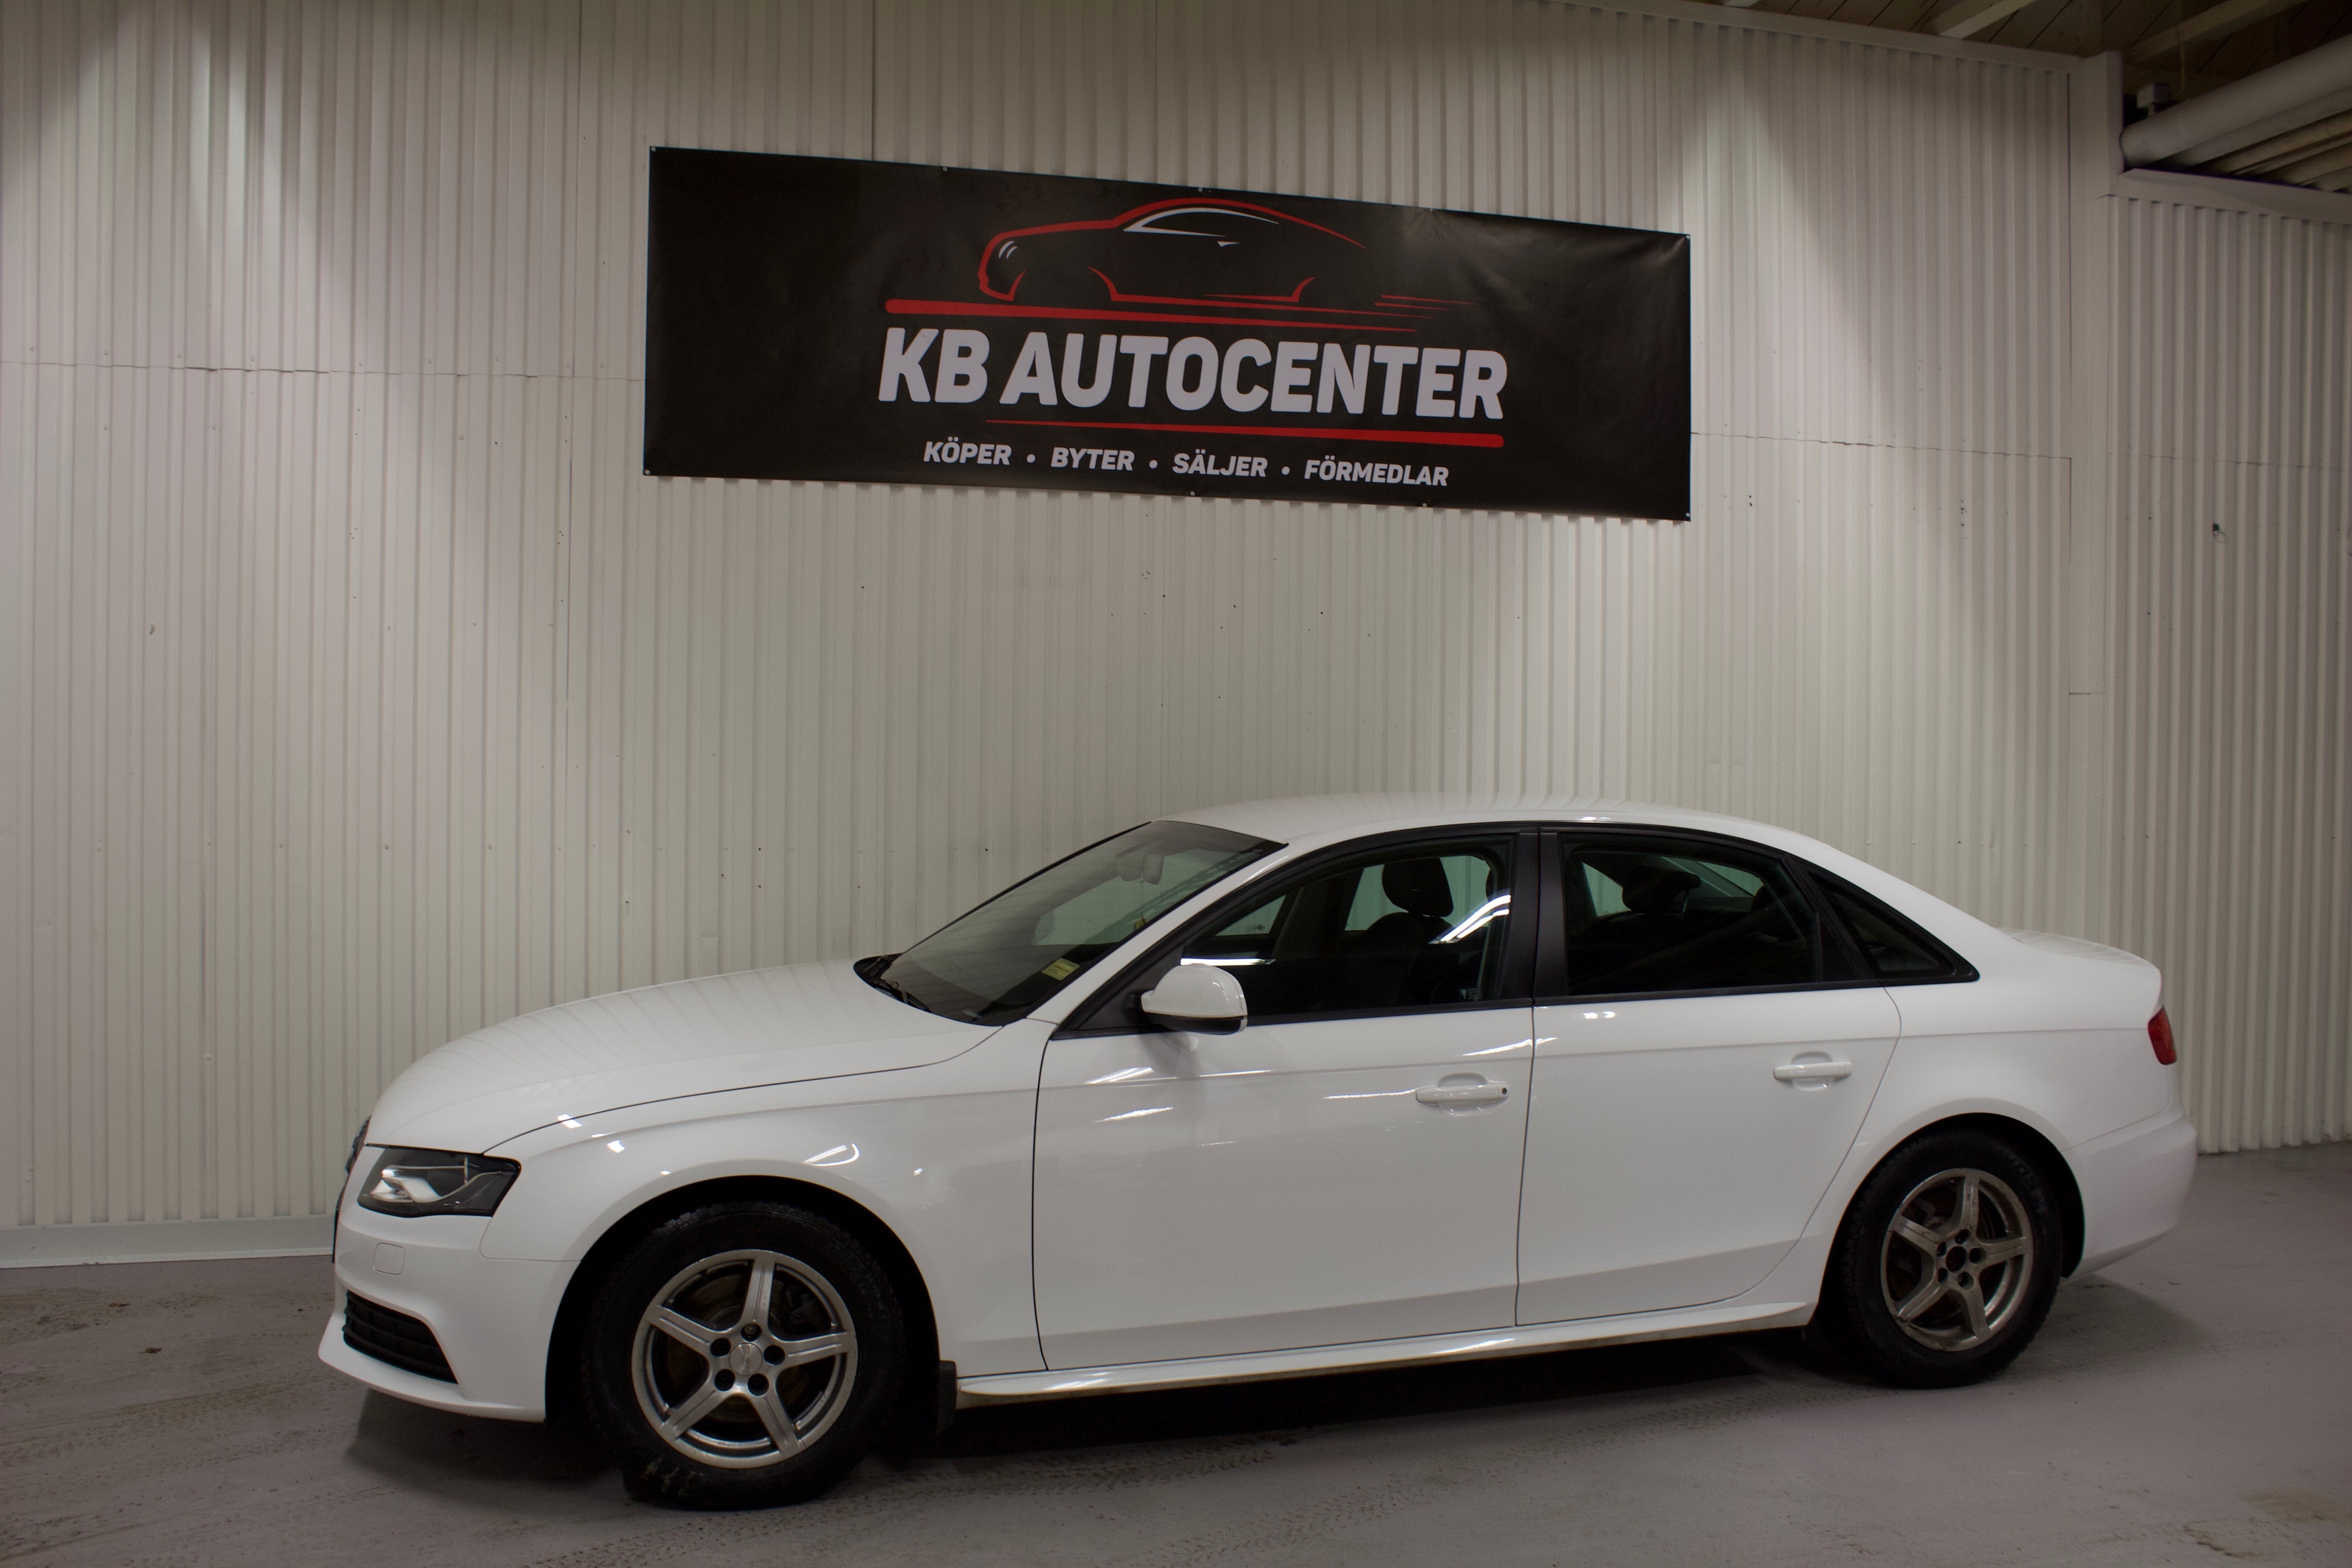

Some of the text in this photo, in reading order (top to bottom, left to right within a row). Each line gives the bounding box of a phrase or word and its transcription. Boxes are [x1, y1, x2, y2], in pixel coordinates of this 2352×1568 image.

[878, 327, 1508, 420] KB AUTOCENTER
[923, 436, 1449, 486] KÖPER BYTER SÄLJER FÖRMEDLAR
